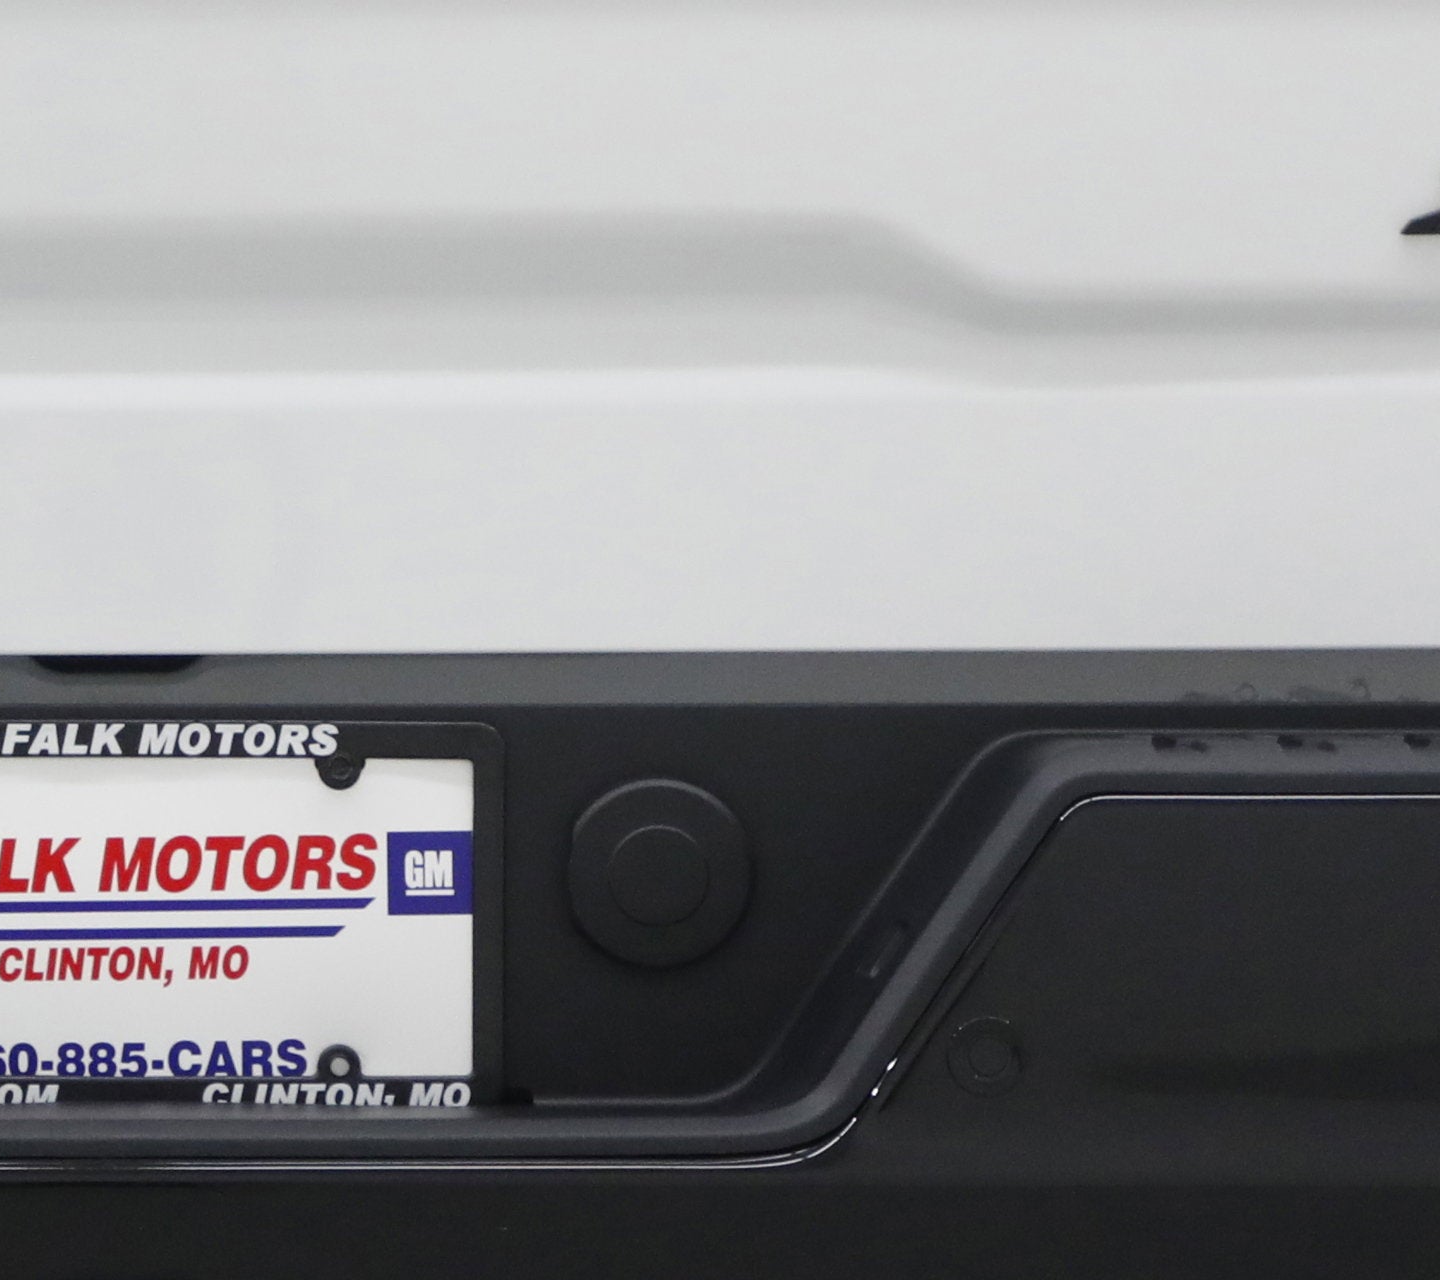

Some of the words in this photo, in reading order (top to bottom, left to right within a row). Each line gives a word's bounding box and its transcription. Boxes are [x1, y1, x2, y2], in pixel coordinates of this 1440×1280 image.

[1, 723, 124, 756] FALK
[137, 722, 339, 756] MOTORS
[98, 833, 378, 893] MOTORS
[404, 850, 454, 889] GM
[188, 945, 250, 980] MO
[409, 1082, 471, 1108] MO
